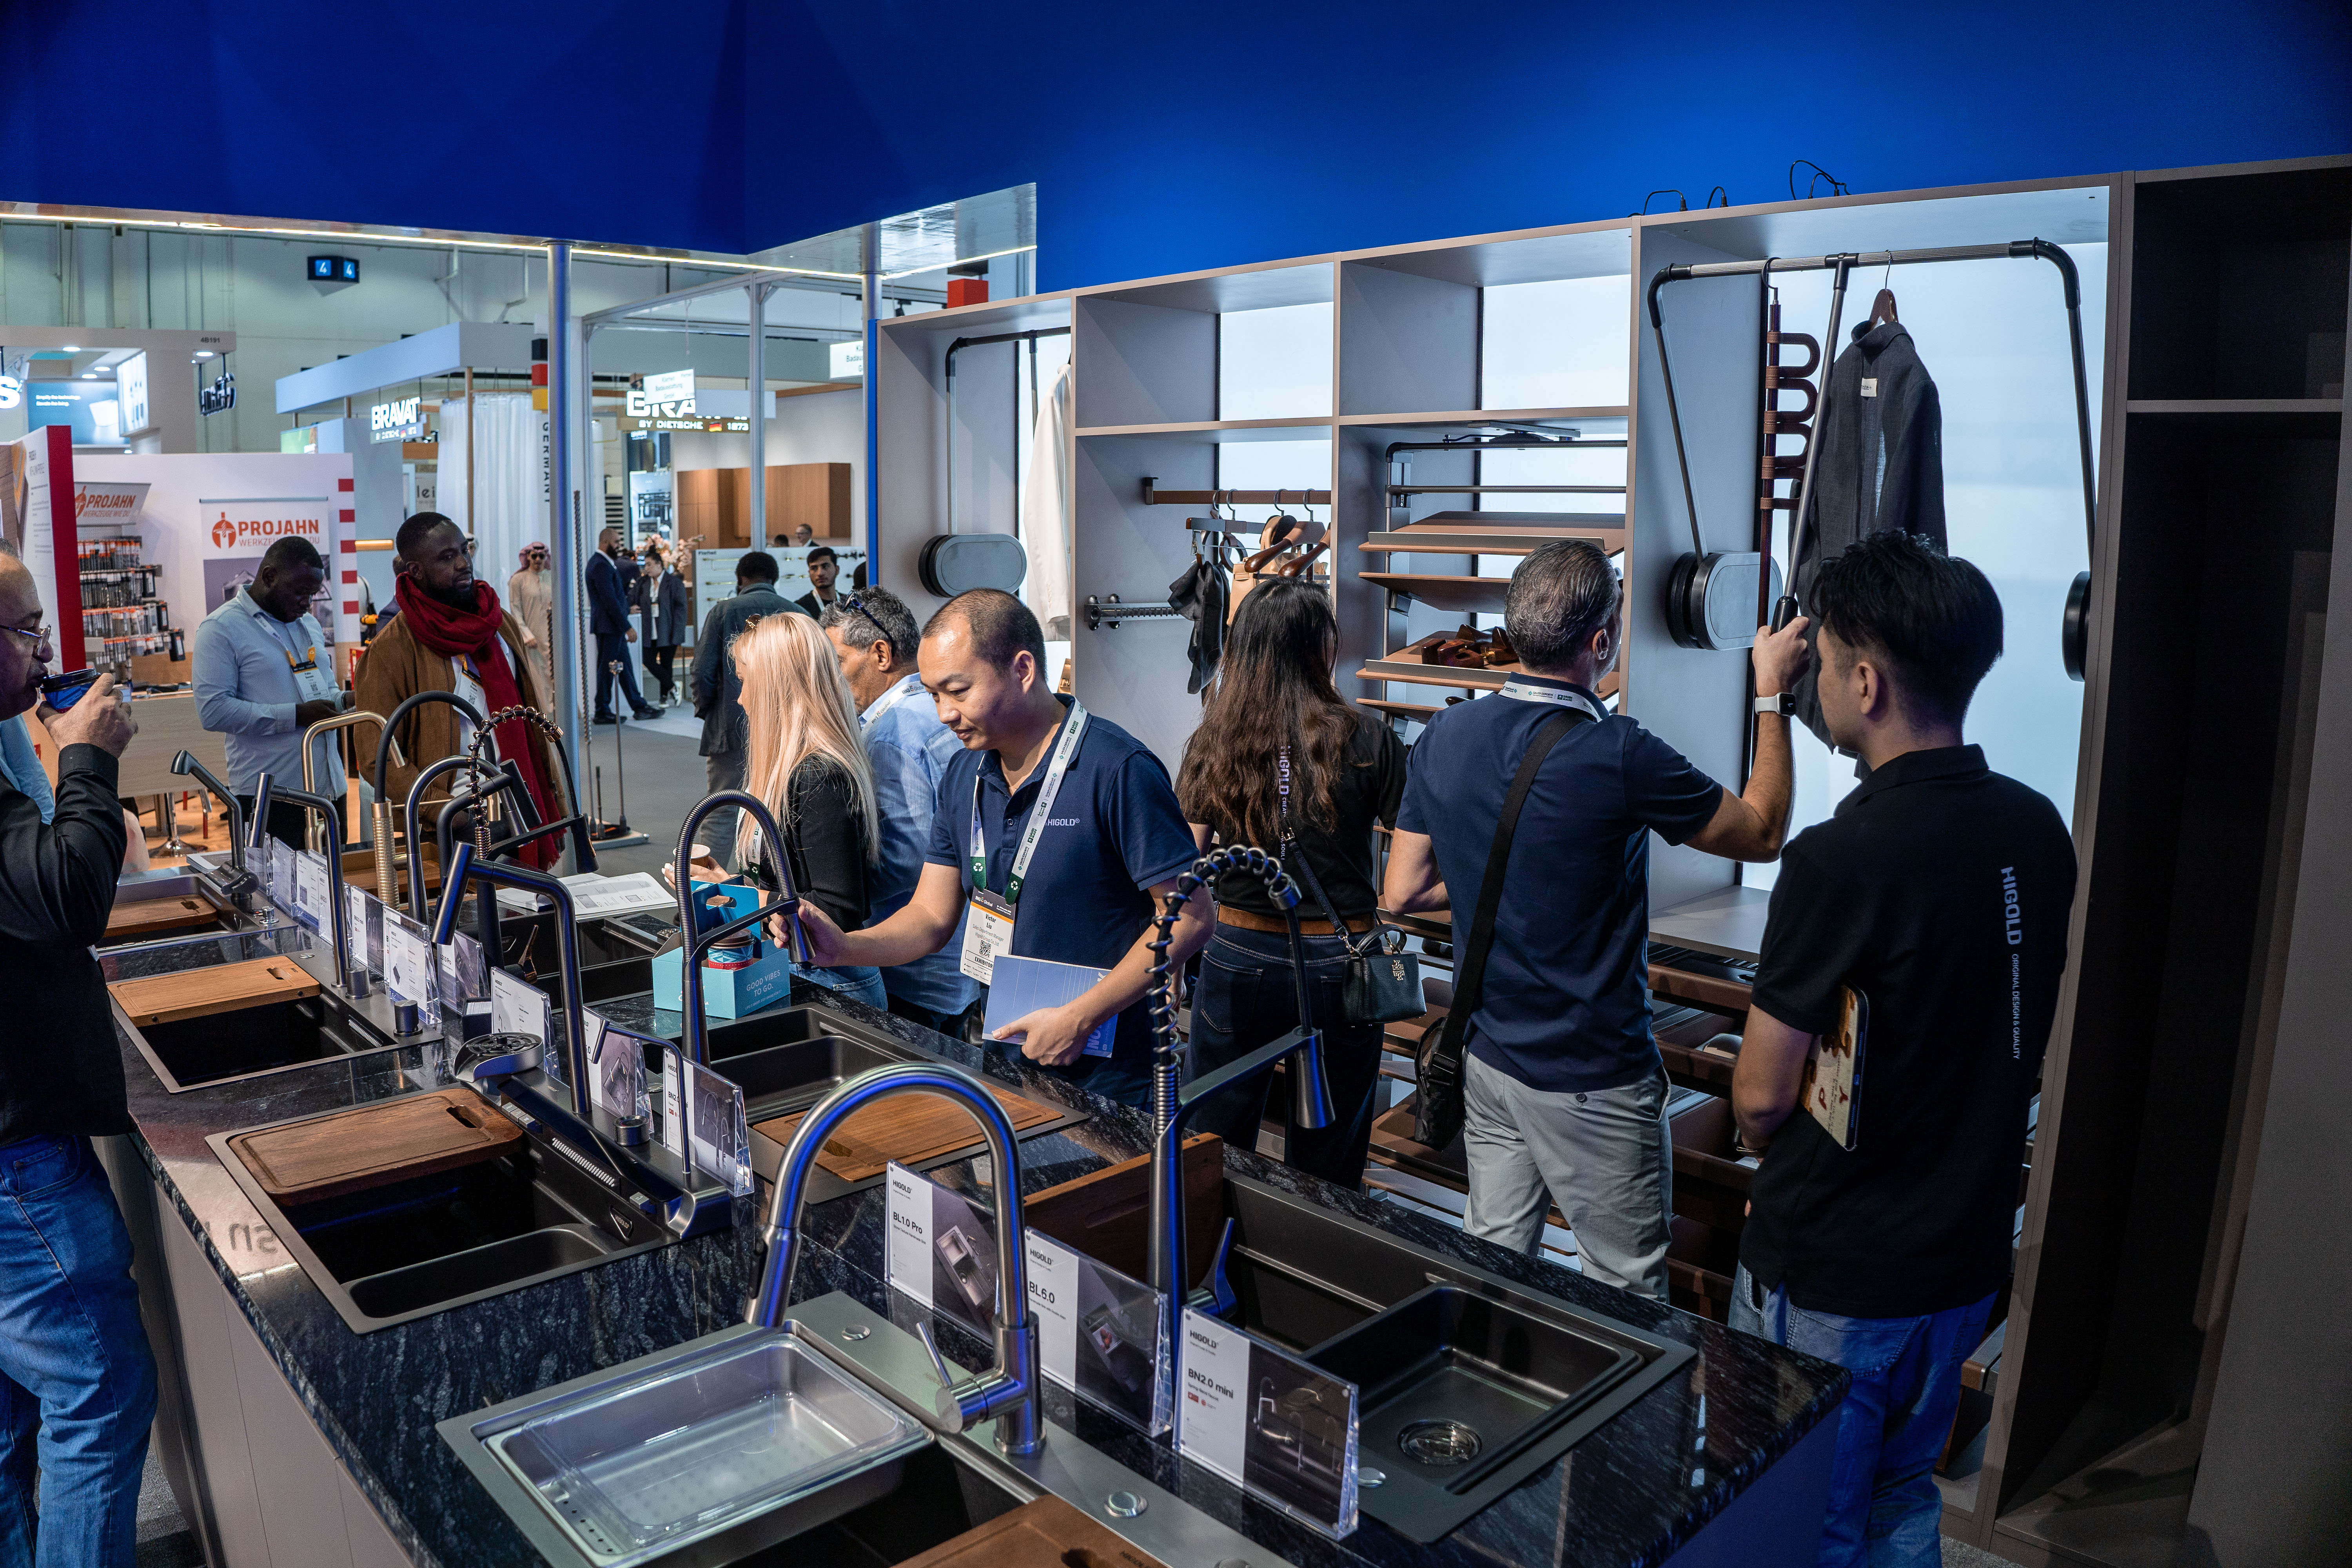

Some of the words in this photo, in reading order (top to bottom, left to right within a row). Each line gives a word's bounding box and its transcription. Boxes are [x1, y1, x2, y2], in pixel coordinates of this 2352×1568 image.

[319, 262, 327, 274] 4
[346, 264, 352, 275] 4
[371, 396, 421, 430] BRAVAT
[639, 419, 653, 428] BY
[656, 420, 703, 430] DIETSCHE
[86, 494, 136, 508] PROJAHN
[238, 519, 319, 536] PROJAHN
[2001, 867, 2022, 945] HIGOLD
[985, 913, 996, 923] Victor
[979, 927, 993, 937] Department
[993, 933, 1004, 942] Manager
[975, 956, 993, 969] EXHIBITOR
[746, 978, 763, 991] GOOD
[764, 970, 780, 981] VIBES
[754, 988, 762, 996] TO
[763, 983, 773, 992] GO.
[893, 1180, 911, 1194] HIGOLD
[893, 1211, 910, 1227] BL1.0
[912, 1221, 922, 1234] Pro
[909, 1232, 921, 1241] Handmade
[1030, 1248, 1052, 1265] HIGOLD
[1029, 1280, 1054, 1304] BL6.0
[1190, 1329, 1217, 1348] HIGOLD
[1188, 1367, 1213, 1388] BN2.0
[1215, 1383, 1233, 1399] mini
